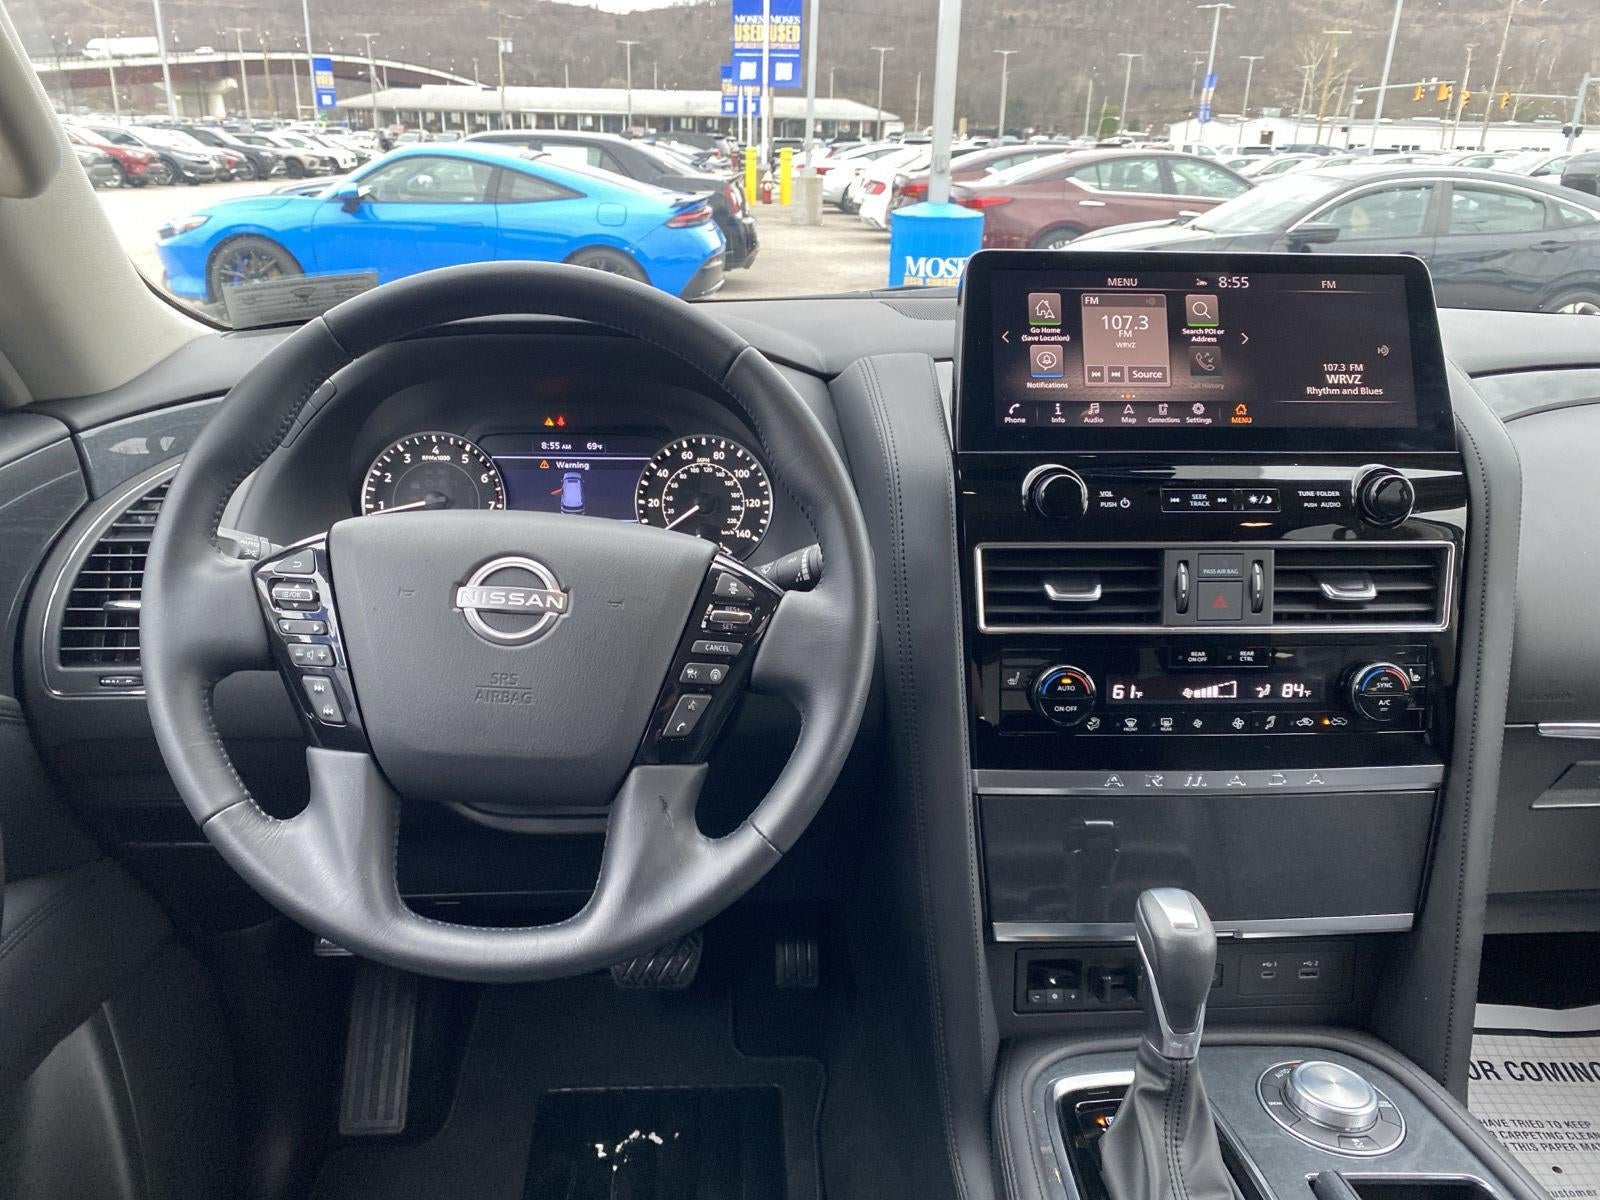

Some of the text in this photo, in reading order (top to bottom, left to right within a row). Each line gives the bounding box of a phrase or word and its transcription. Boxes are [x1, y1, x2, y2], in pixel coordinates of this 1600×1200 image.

[734, 24, 764, 42] USED
[769, 25, 801, 43] USED
[1107, 277, 1138, 287] MENU
[1217, 275, 1250, 289] 8:55
[1321, 280, 1337, 289] FM
[1084, 296, 1099, 305] FM
[1100, 315, 1150, 330] 107.3
[1021, 334, 1070, 342] (Save Location)
[1118, 329, 1133, 338] FM
[1115, 341, 1136, 349] WRVZ
[1322, 363, 1364, 372] 107.3 FM
[1132, 370, 1163, 379] Source
[1326, 374, 1363, 384] WRVZ
[1026, 381, 1069, 389] Notifications
[1203, 382, 1225, 391] History
[1306, 386, 1384, 396] Rhythm and Blues
[1004, 416, 1026, 424] Phone
[1051, 416, 1066, 424] Info
[1083, 416, 1104, 424] Audio
[1121, 416, 1137, 425] Map
[1147, 416, 1181, 424] Connections
[1185, 416, 1213, 425] Settings
[1231, 416, 1253, 424] MENU
[431, 445, 440, 455] 4
[540, 441, 560, 450] 8:55
[403, 453, 412, 464] 3
[461, 453, 469, 464] 5
[681, 451, 694, 460] 60
[713, 451, 725, 460] 80
[555, 461, 590, 470] Warning
[383, 472, 392, 483] 2
[656, 468, 669, 478] 40
[733, 469, 750, 478] 100
[480, 473, 489, 483] 6
[378, 501, 385, 510] 1
[487, 501, 496, 511] 7
[648, 498, 660, 508] 20
[744, 498, 761, 508] 120
[1189, 500, 1211, 508] TRACK
[735, 529, 751, 538] 140
[461, 590, 564, 610] NISSAN
[704, 643, 731, 653] CANCEL
[489, 672, 518, 686] SRS
[474, 689, 533, 705] AIRBAG
[1510, 1119, 1545, 1129] TRIED
[1546, 1120, 1563, 1129] TO
[1564, 1120, 1591, 1129] KEEP
[1499, 1131, 1564, 1140] CARPETING
[1509, 1142, 1539, 1152] THIS
[1540, 1142, 1579, 1152] PAPER
